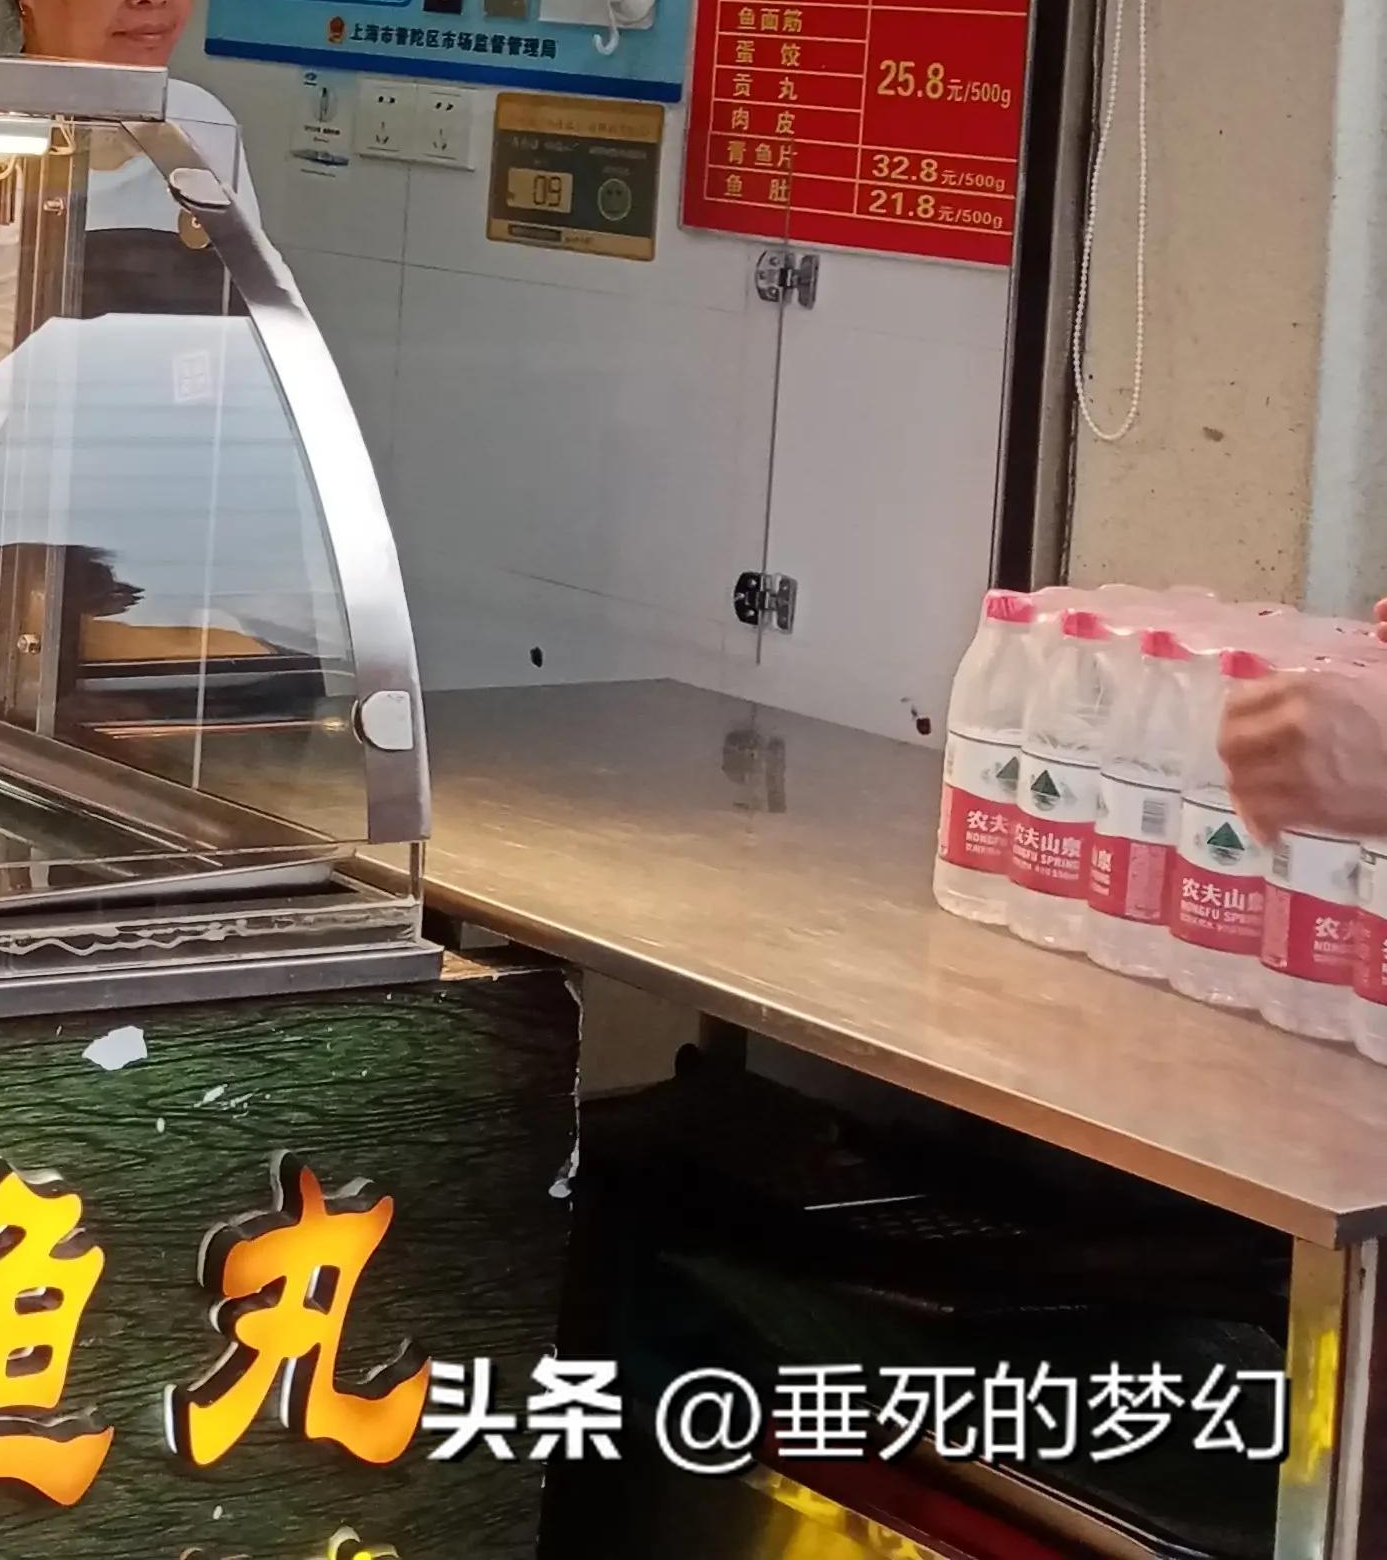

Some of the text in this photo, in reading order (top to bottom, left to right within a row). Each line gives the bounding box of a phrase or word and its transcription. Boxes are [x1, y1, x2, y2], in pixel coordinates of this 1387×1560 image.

[736, 6, 804, 33] 鱼面筋
[349, 22, 557, 60] 上海市普陀区市场监督管理局
[876, 58, 1012, 110] 25.8元/500g
[871, 153, 1007, 193] 32.8元/500g
[868, 189, 1004, 230] 21.8元/500g
